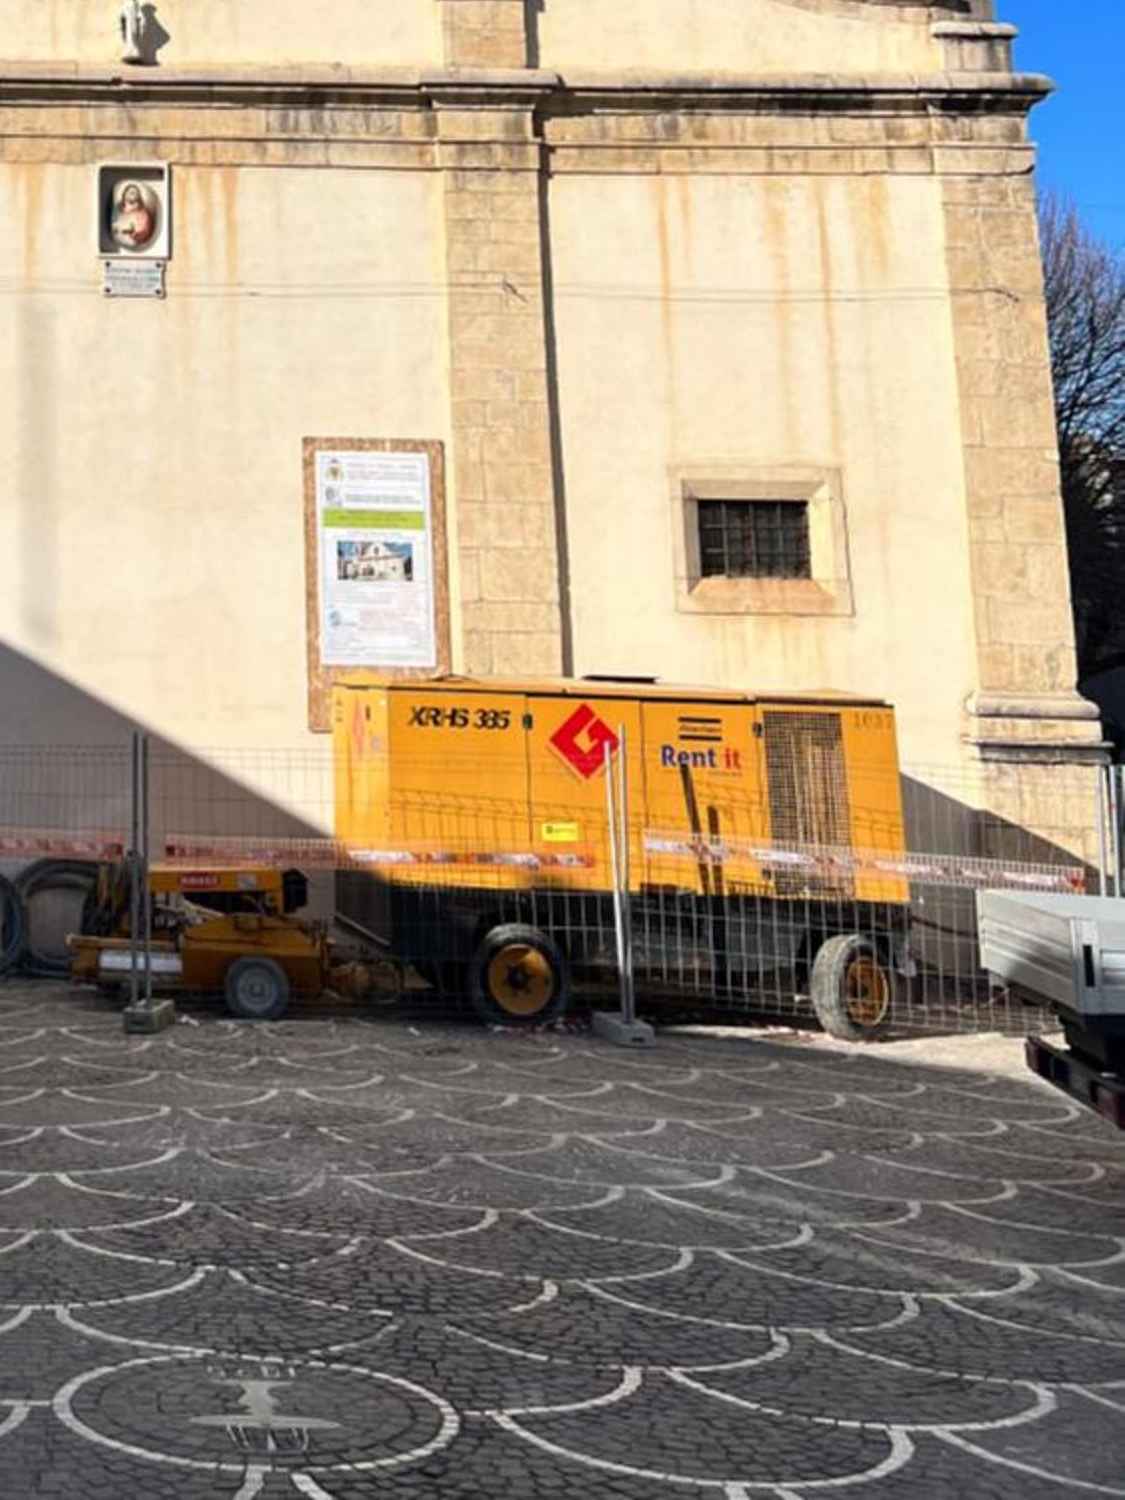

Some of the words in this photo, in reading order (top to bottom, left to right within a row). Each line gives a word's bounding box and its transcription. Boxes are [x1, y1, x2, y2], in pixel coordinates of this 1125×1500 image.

[408, 706, 470, 727] XRHS
[473, 708, 511, 730] 385
[661, 743, 716, 768] Rent
[723, 746, 742, 769] it
